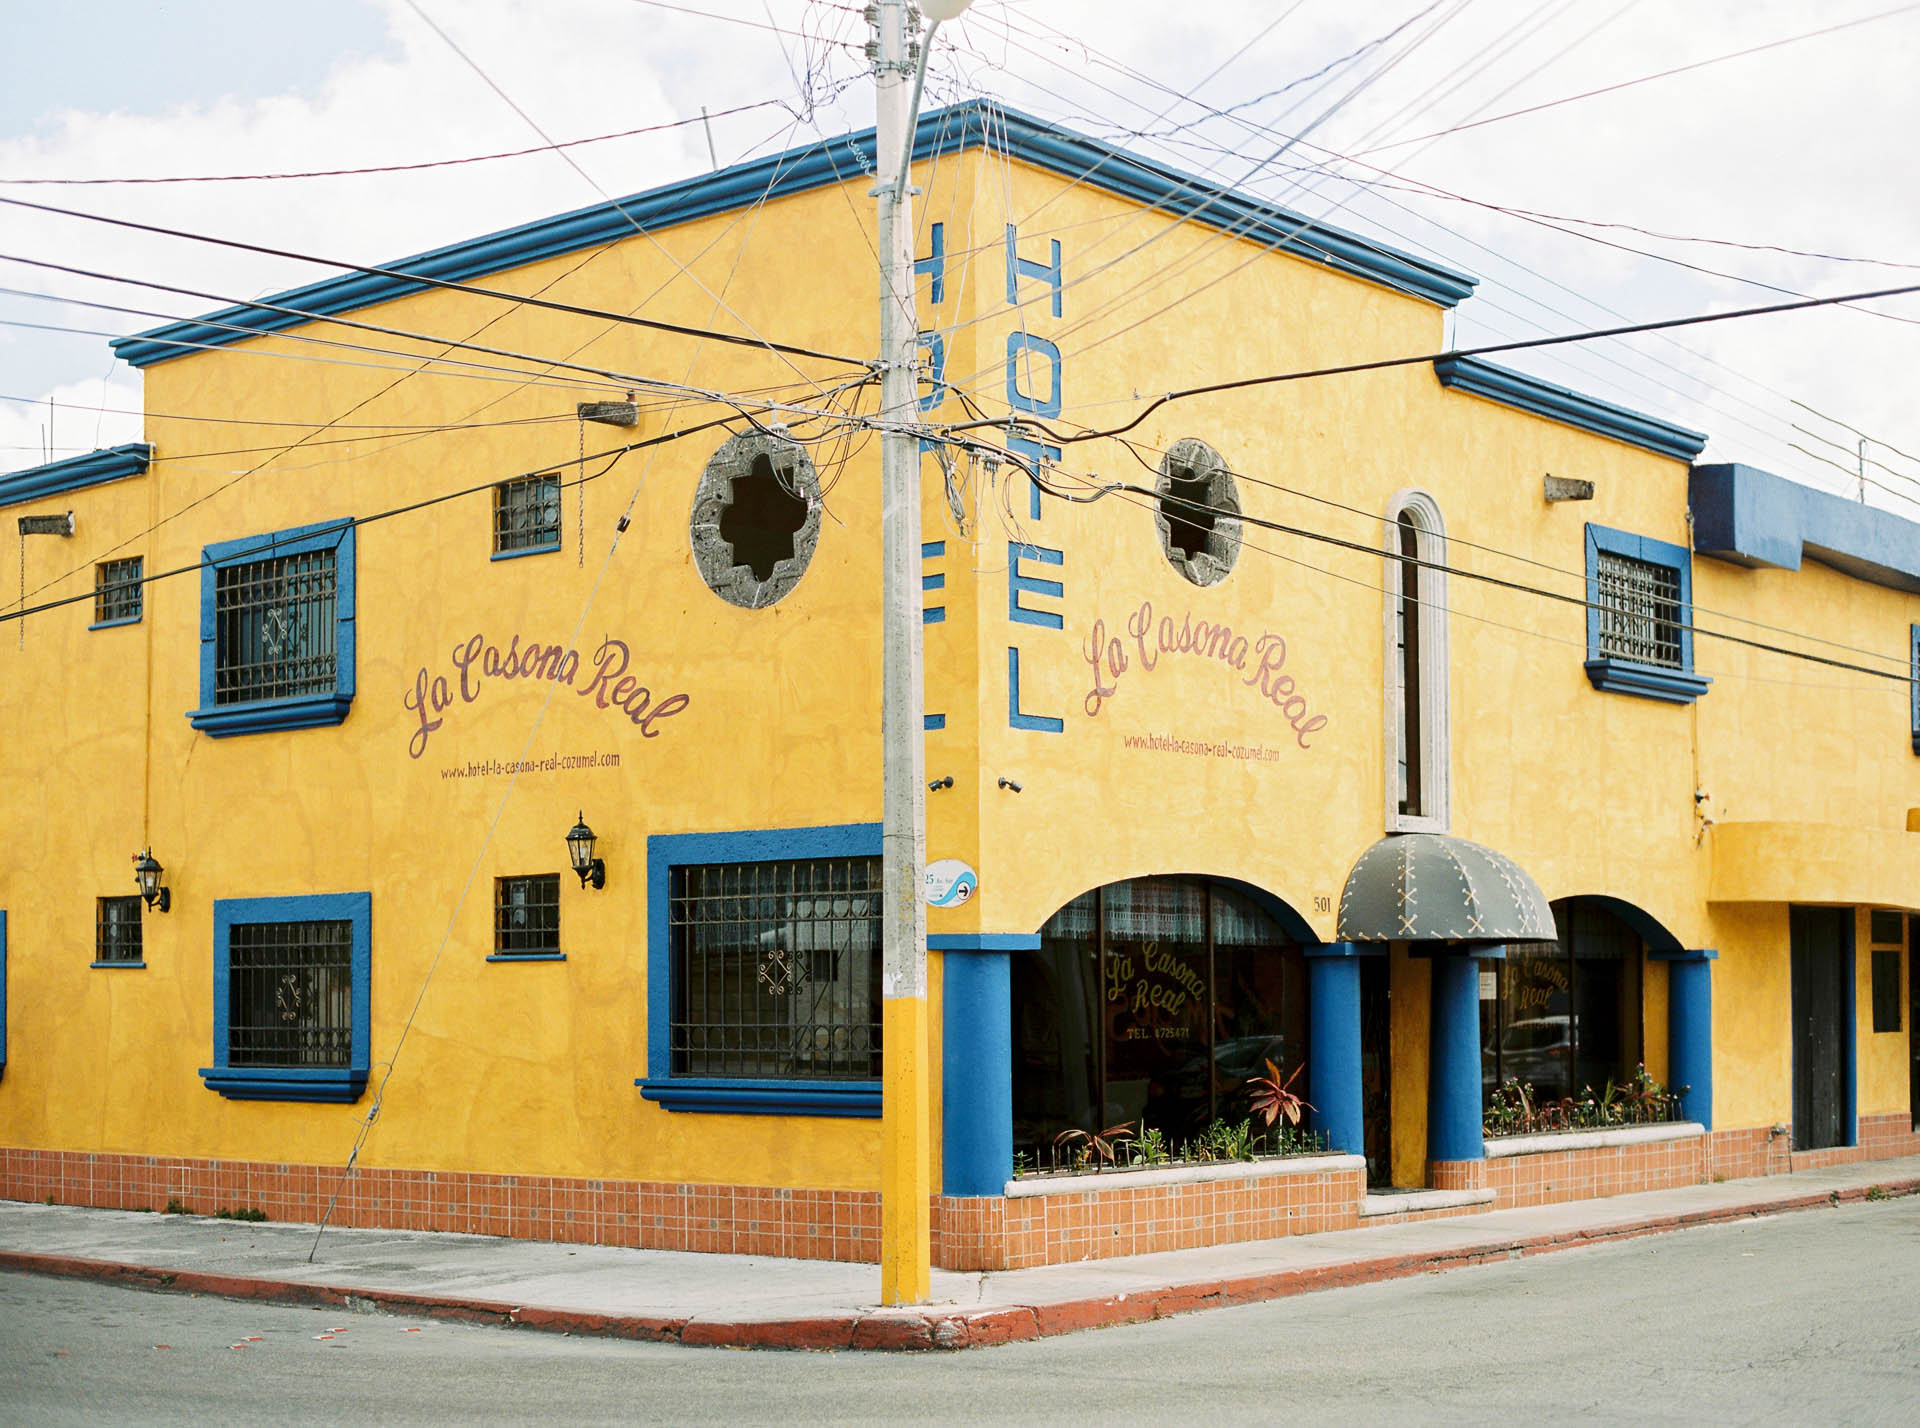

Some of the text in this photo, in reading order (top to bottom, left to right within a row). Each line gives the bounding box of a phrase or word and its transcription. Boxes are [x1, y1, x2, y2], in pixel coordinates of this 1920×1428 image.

[1006, 222, 1063, 733] HOTEL
[1083, 601, 1328, 749] La Casona Real
[404, 632, 690, 759] La Casona Real
[1124, 732, 1280, 761] www.hotel-la-casona-real-cozumel.com
[441, 751, 620, 780] www.hotel-la-casona-real-cozumel.com
[1313, 896, 1331, 912] 501
[1106, 940, 1206, 1001] La Casona
[1132, 978, 1186, 1015] Real
[1126, 1027, 1152, 1039] TEL.
